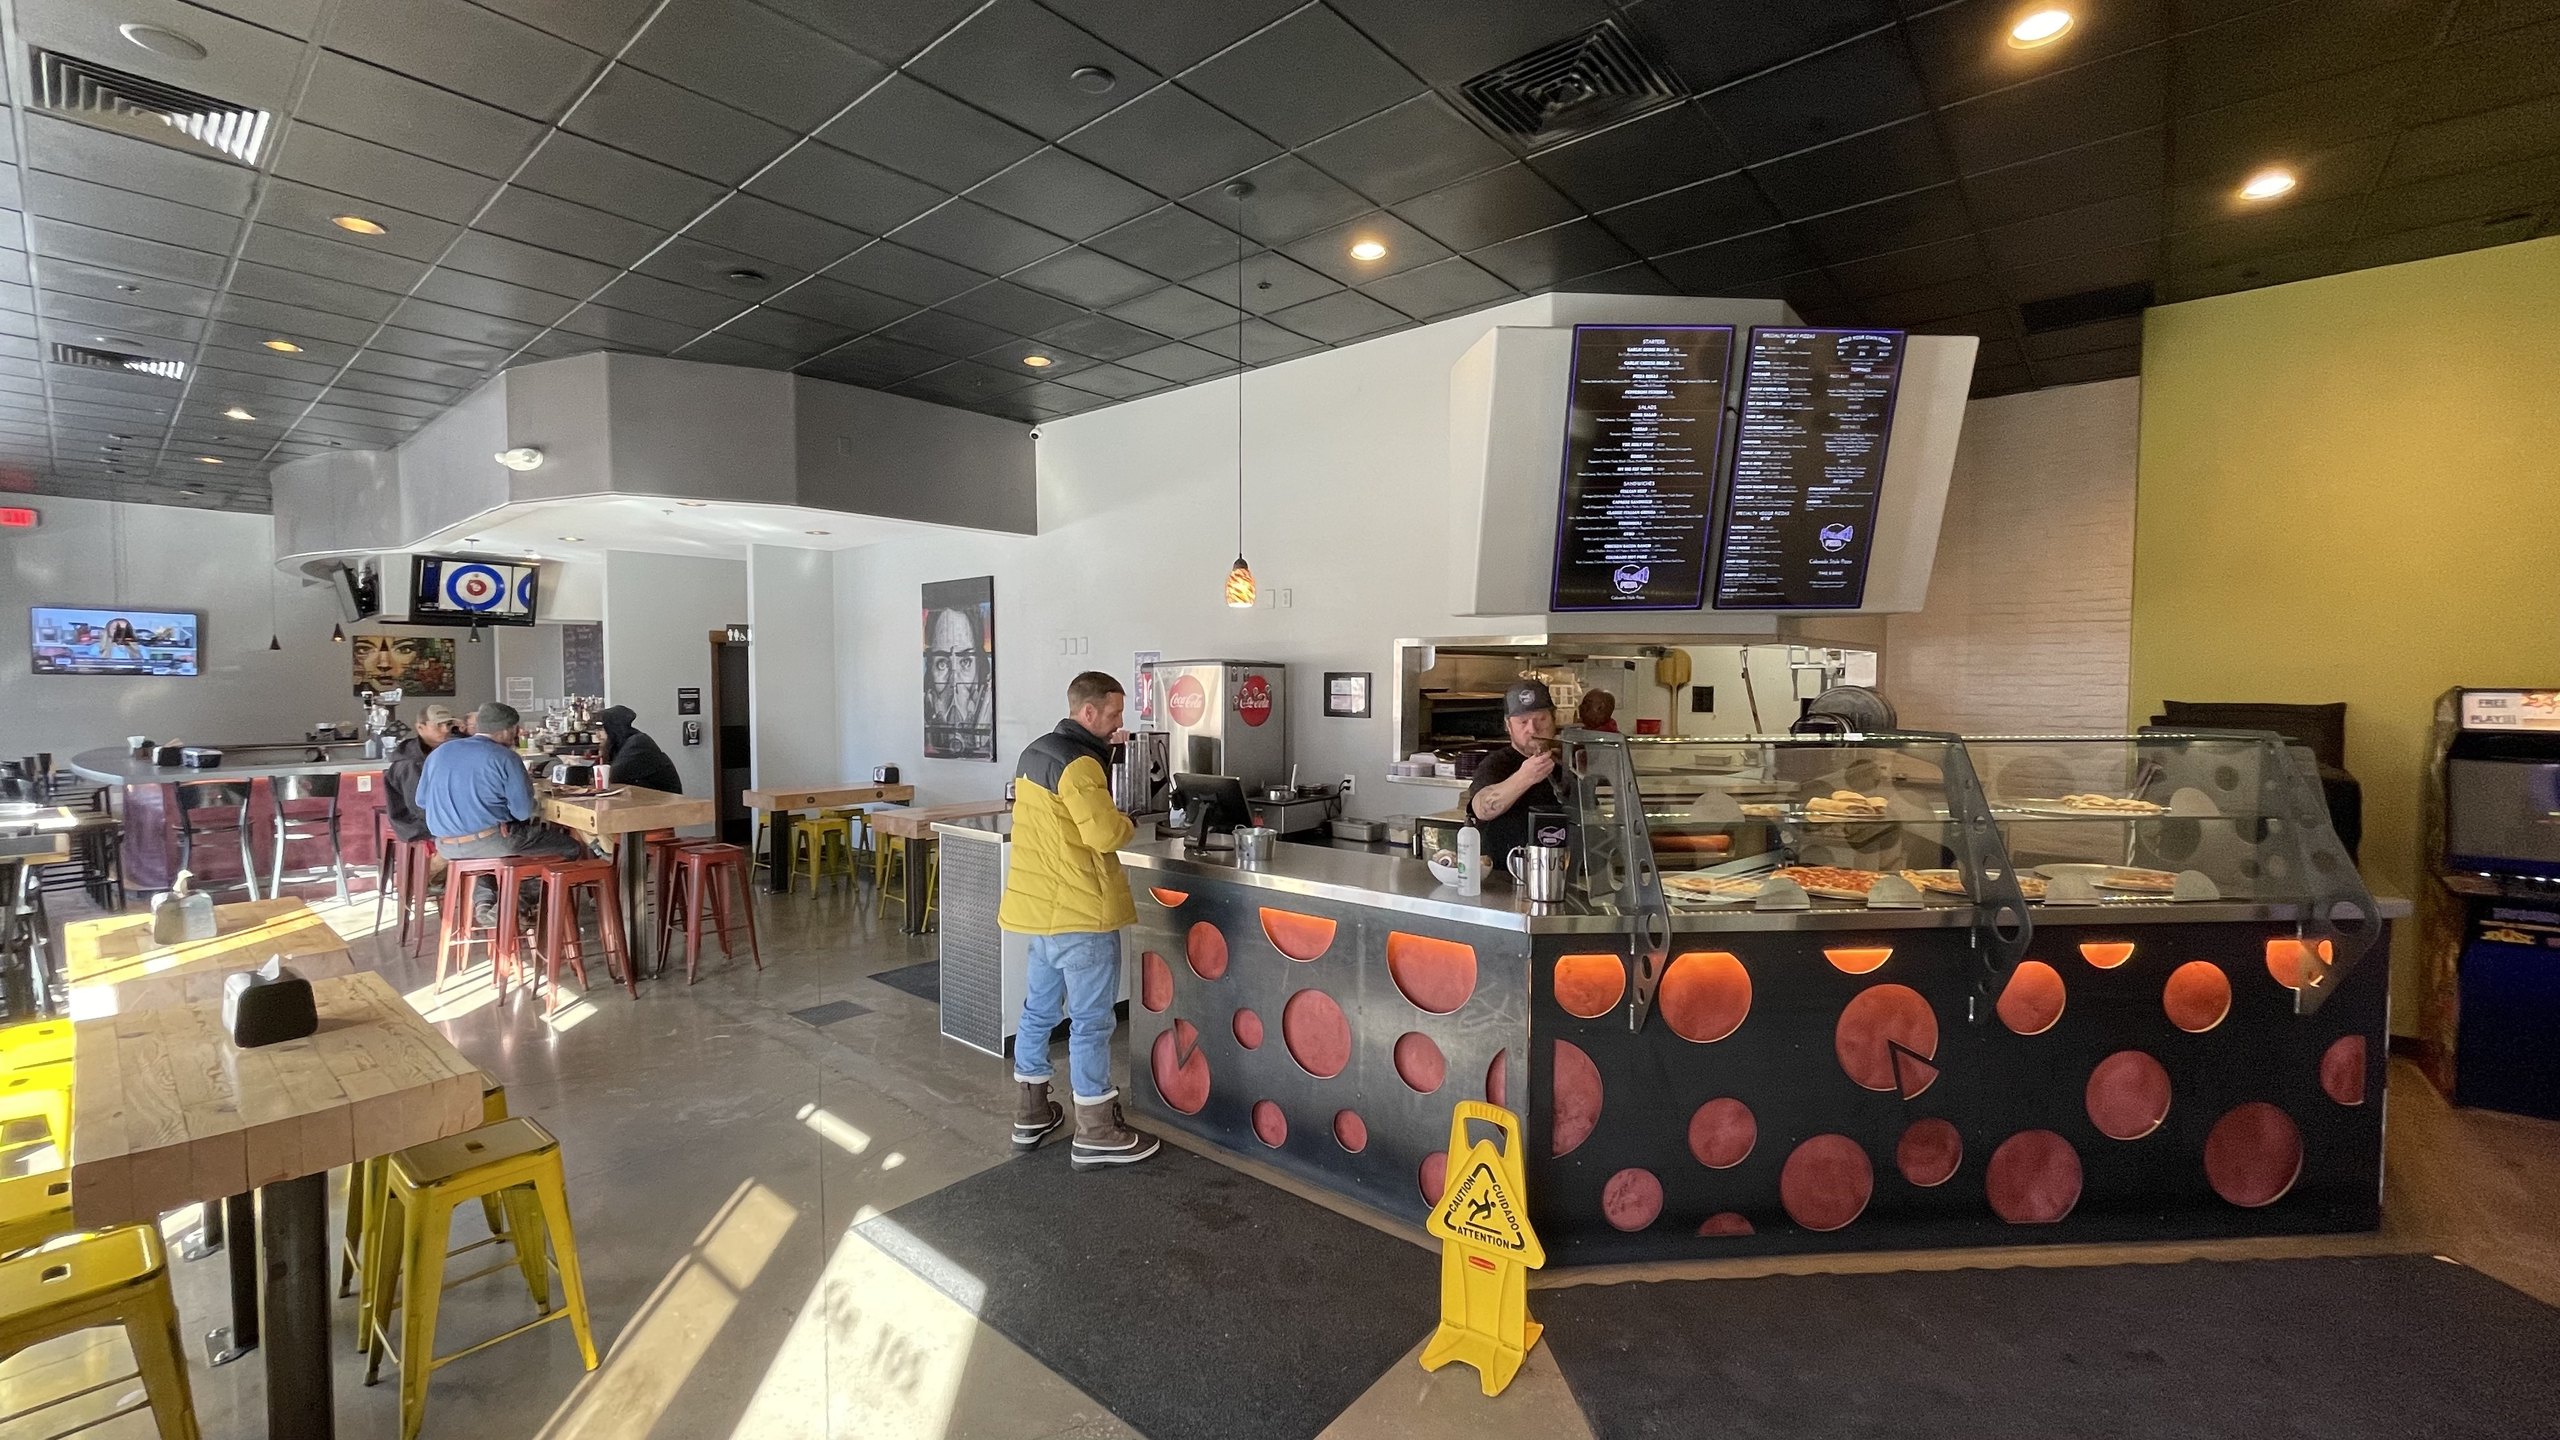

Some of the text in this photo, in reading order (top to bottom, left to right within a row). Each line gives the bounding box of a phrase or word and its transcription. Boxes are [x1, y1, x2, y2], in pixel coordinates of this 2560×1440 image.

[1448, 1175, 1476, 1213] CAUTION
[1492, 1184, 1520, 1231] CUIDADO
[1457, 1226, 1510, 1250] ATTENTION
